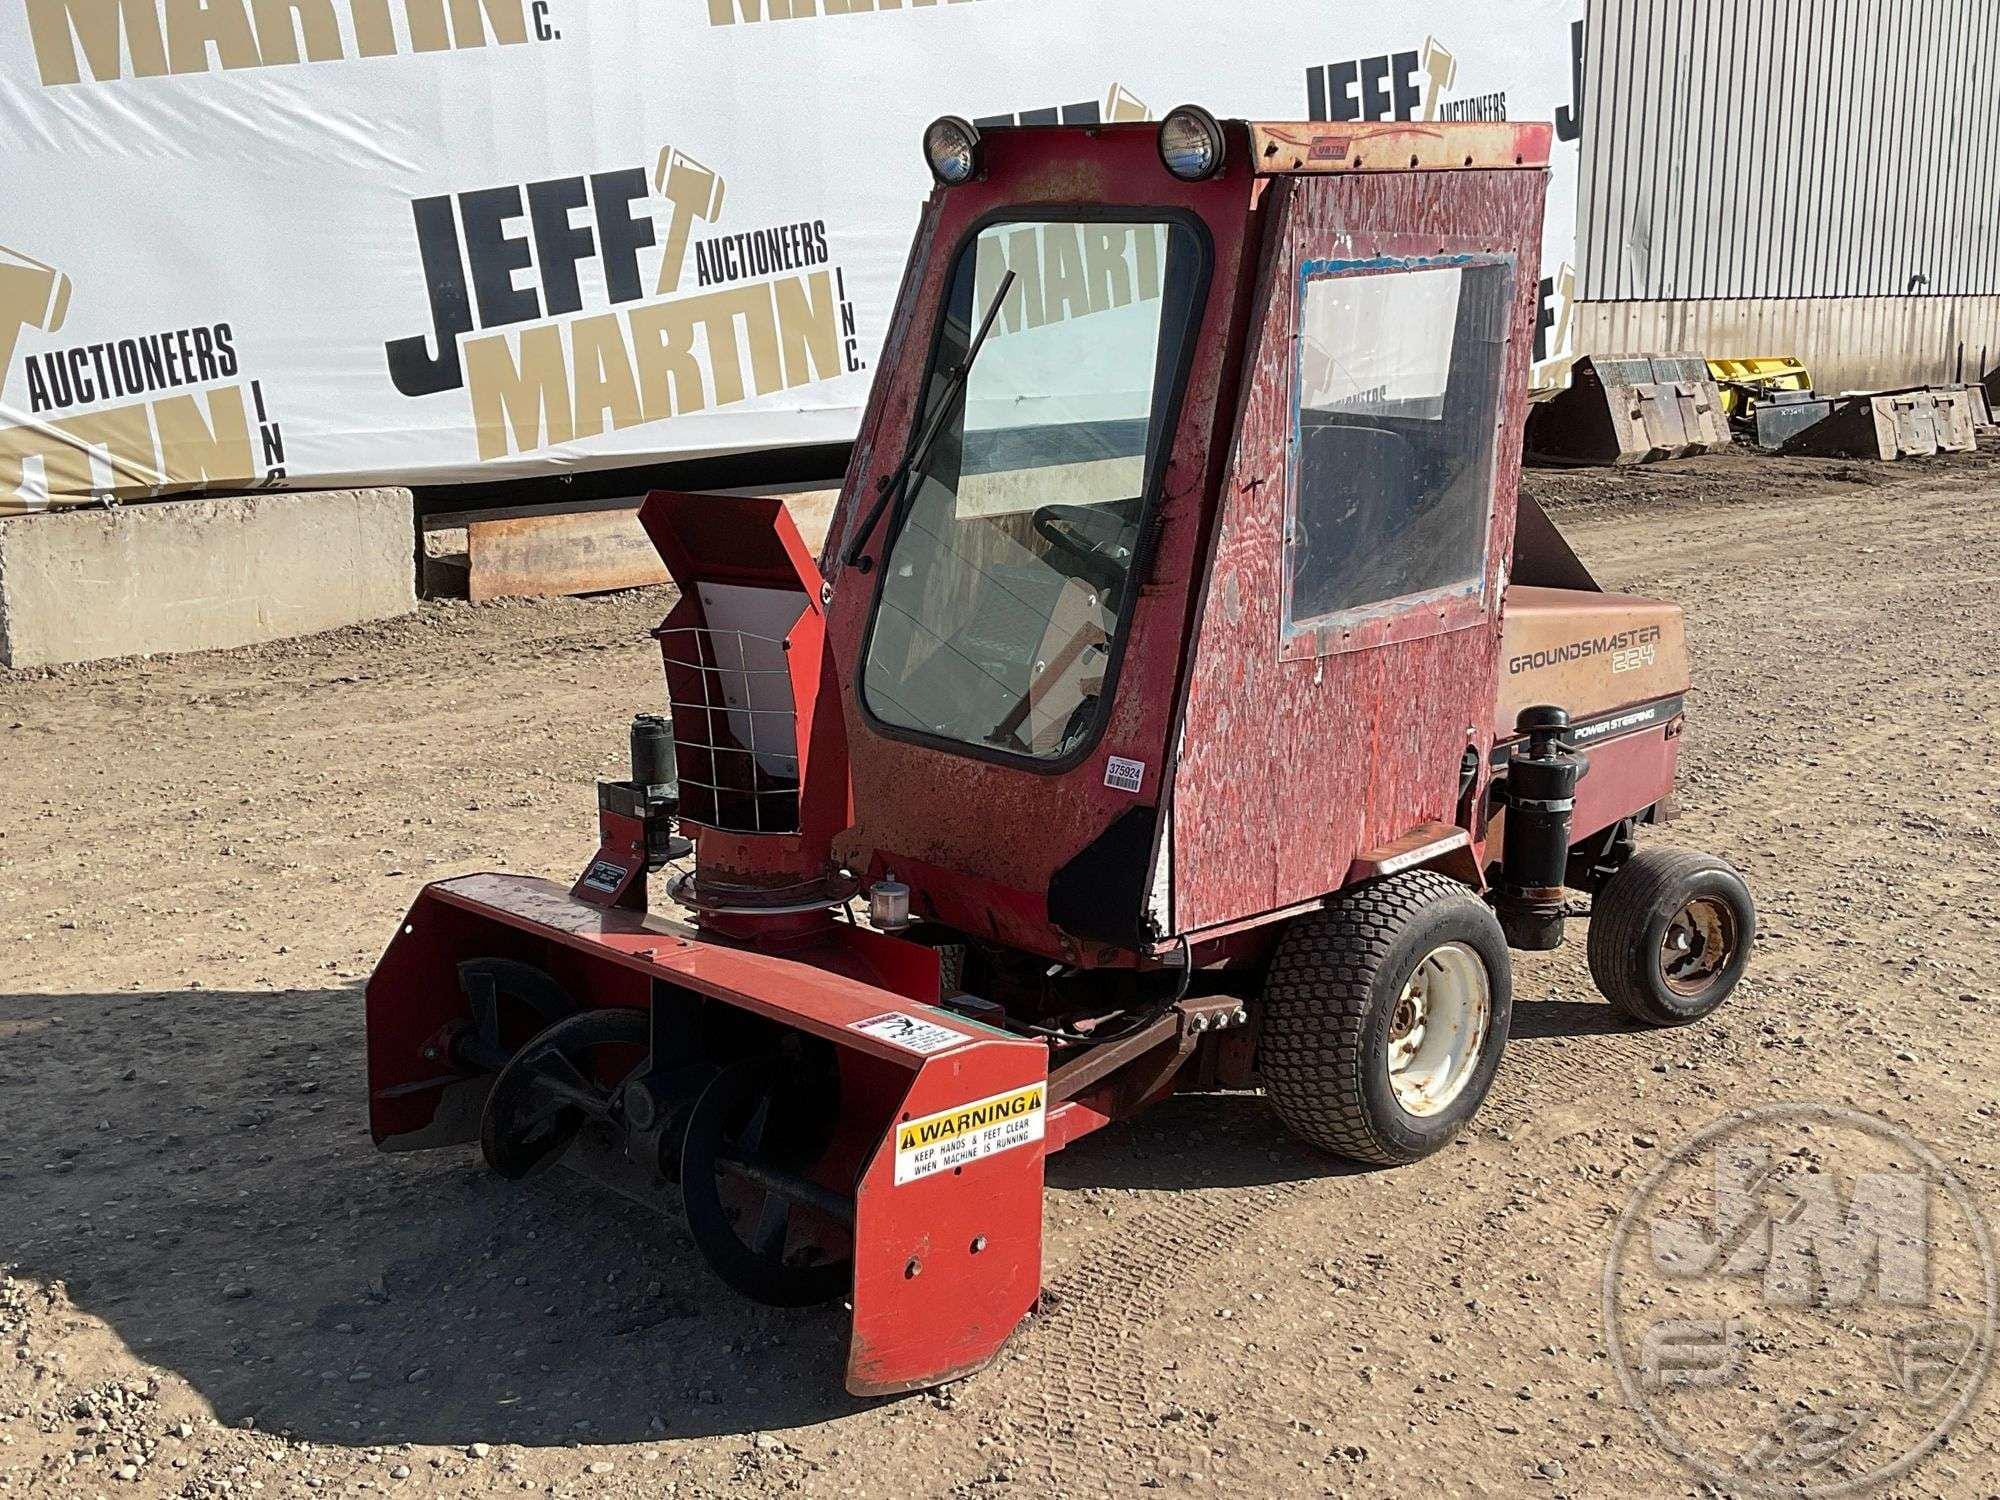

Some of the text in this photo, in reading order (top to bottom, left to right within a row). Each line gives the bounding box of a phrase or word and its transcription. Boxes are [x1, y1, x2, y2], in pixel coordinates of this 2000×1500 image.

[696, 219, 829, 287] AUCTIONEERS
[385, 167, 656, 397] JEFF
[835, 267, 867, 373] INC.
[25, 323, 238, 413] AUCTIONEERS
[463, 270, 842, 462] MARTIN
[1509, 625, 1661, 675] GROUNDSMASTER
[1612, 645, 1656, 674] 224
[1574, 708, 1655, 740] POWER STEERING
[1109, 763, 1141, 779] 375924
[914, 1119, 1029, 1163] KEEP HANDS & FEET CLEAR
[920, 1096, 1025, 1142] WARNING
[914, 1131, 1029, 1176] WHEN MACHINE IS RUNNING
